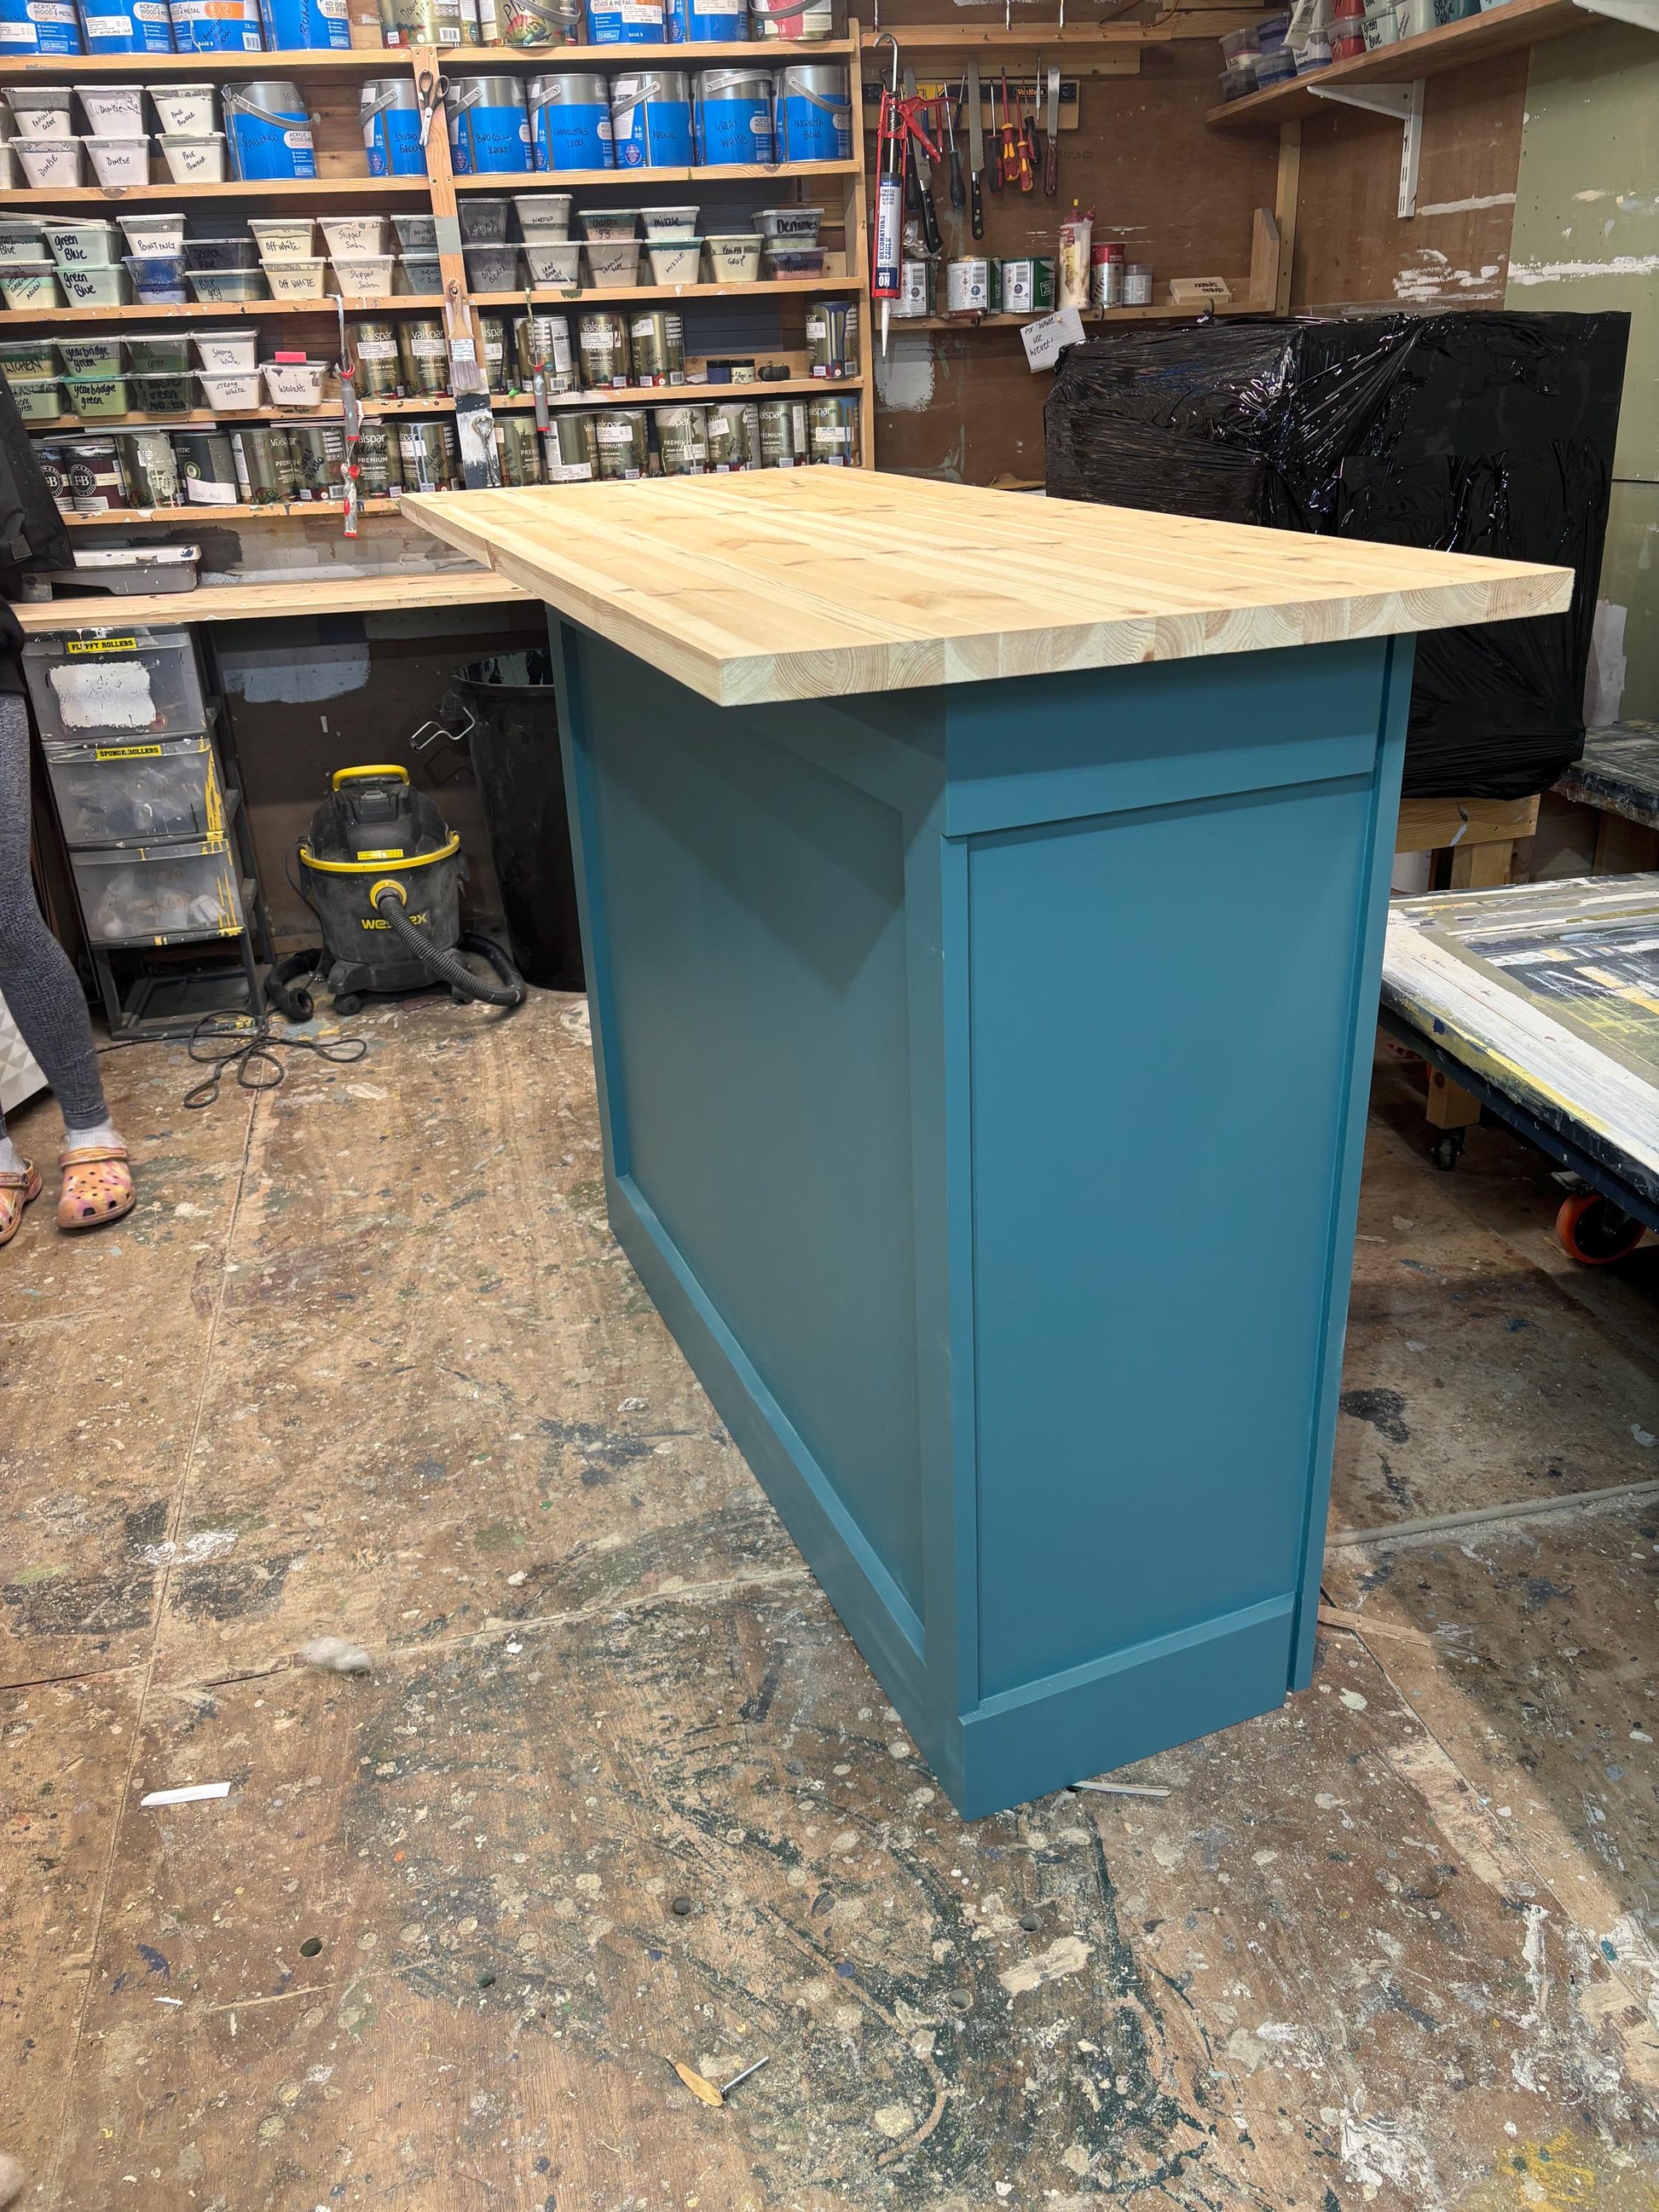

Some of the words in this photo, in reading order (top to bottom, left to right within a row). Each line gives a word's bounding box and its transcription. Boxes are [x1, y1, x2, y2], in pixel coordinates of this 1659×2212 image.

[1016, 87, 1044, 96] VonHas
[64, 248, 87, 261] Blue
[292, 278, 316, 288] WHITE
[73, 285, 96, 297] Blue
[361, 330, 393, 342] valspar
[412, 328, 444, 341] valspar
[5, 357, 44, 373] LICHEN
[760, 410, 782, 421] alspar
[810, 406, 831, 416] alspar
[356, 433, 386, 444] alspar
[101, 639, 134, 649] ROLLERS
